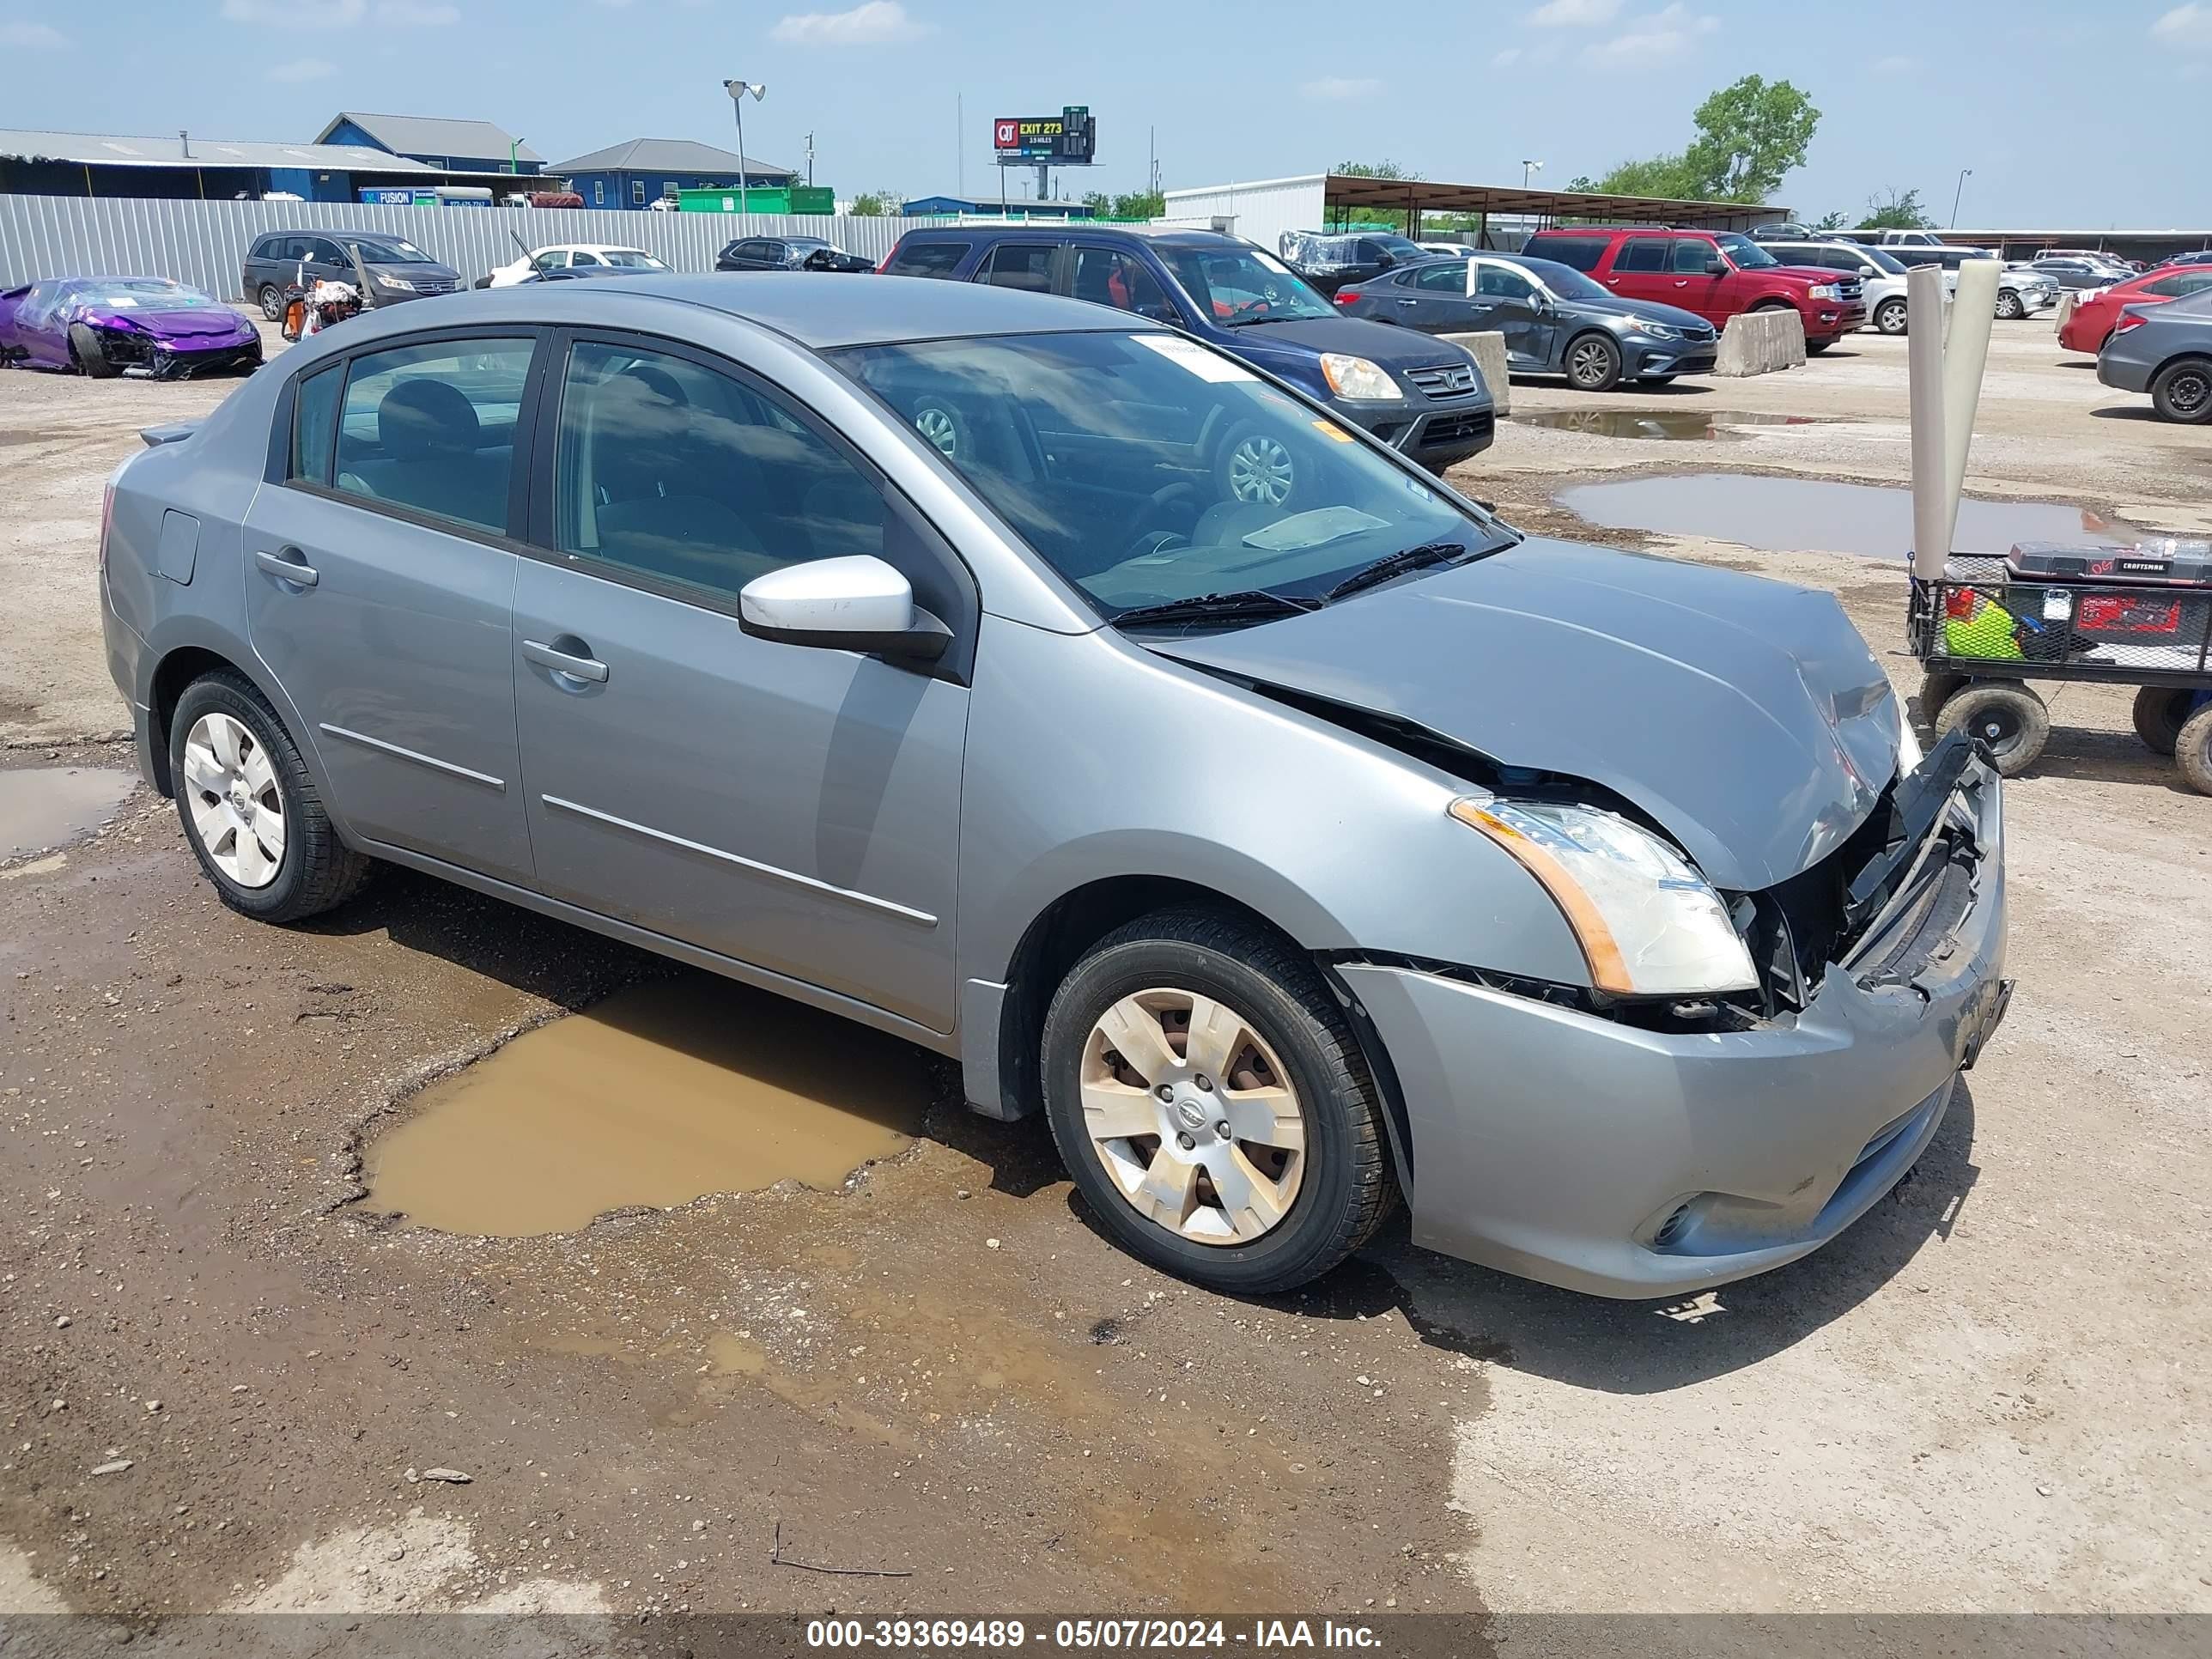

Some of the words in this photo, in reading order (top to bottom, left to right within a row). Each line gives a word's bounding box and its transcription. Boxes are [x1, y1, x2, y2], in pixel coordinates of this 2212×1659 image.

[998, 125, 1015, 143] QT
[1020, 123, 1041, 134] EXIT
[1043, 123, 1062, 134] 273
[380, 191, 410, 204] FUSION
[2123, 562, 2163, 571] CRAFTSMAN
